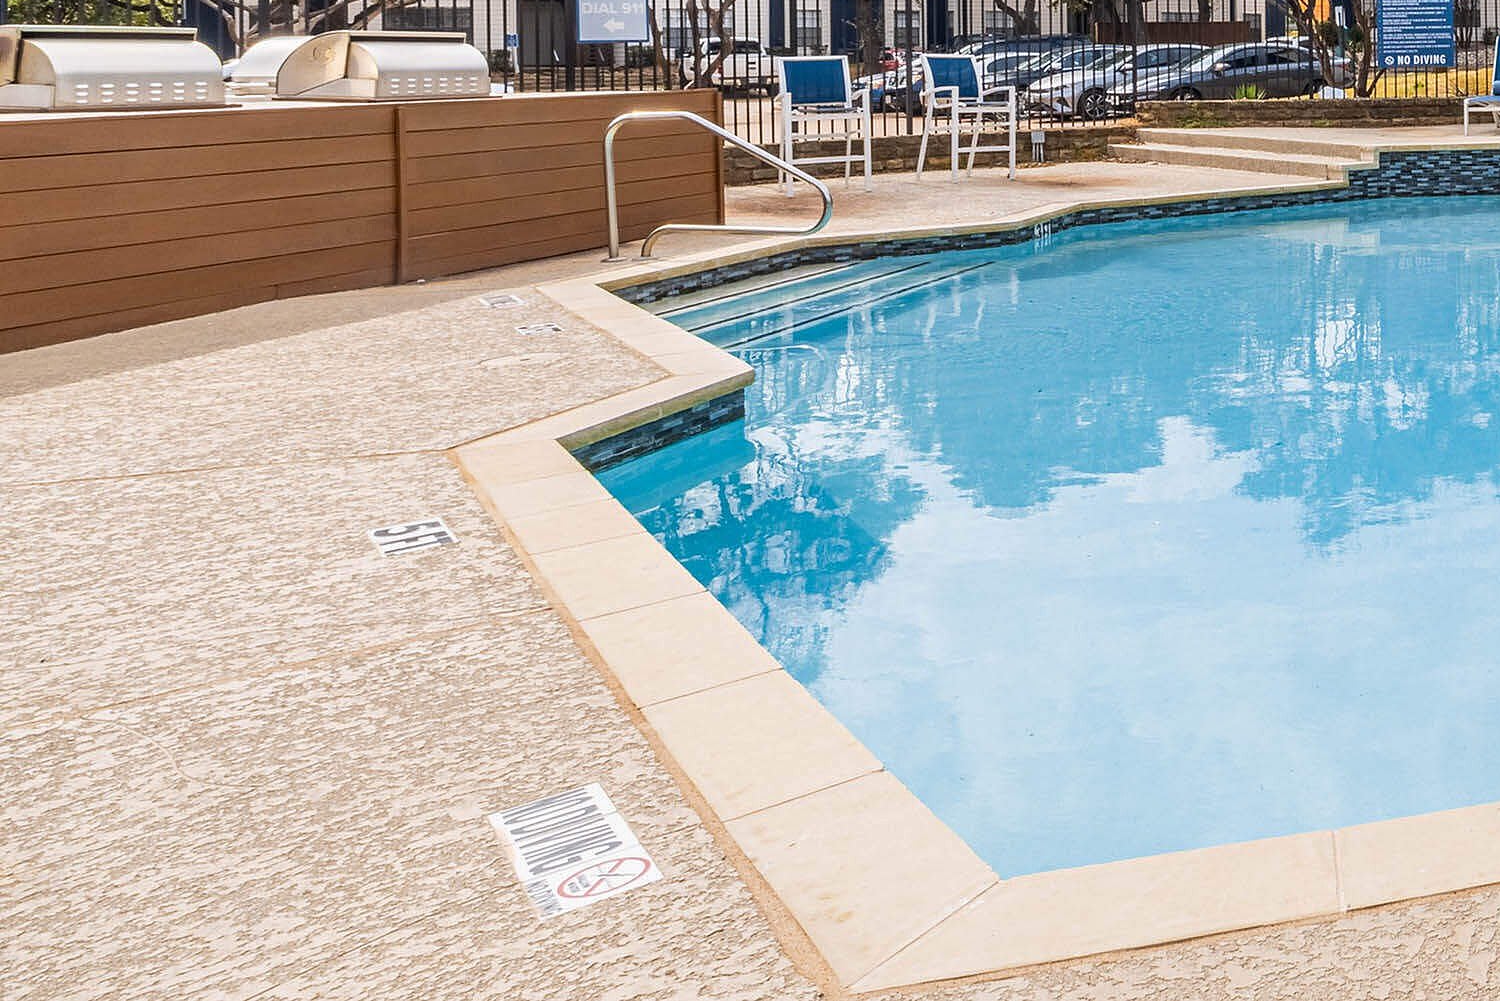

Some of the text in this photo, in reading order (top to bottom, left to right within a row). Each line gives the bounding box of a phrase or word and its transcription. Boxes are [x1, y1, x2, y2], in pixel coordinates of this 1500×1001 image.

[584, 1, 644, 14] DIAL 911
[1397, 54, 1447, 65] NO DIVING
[510, 804, 623, 875] DIVING
